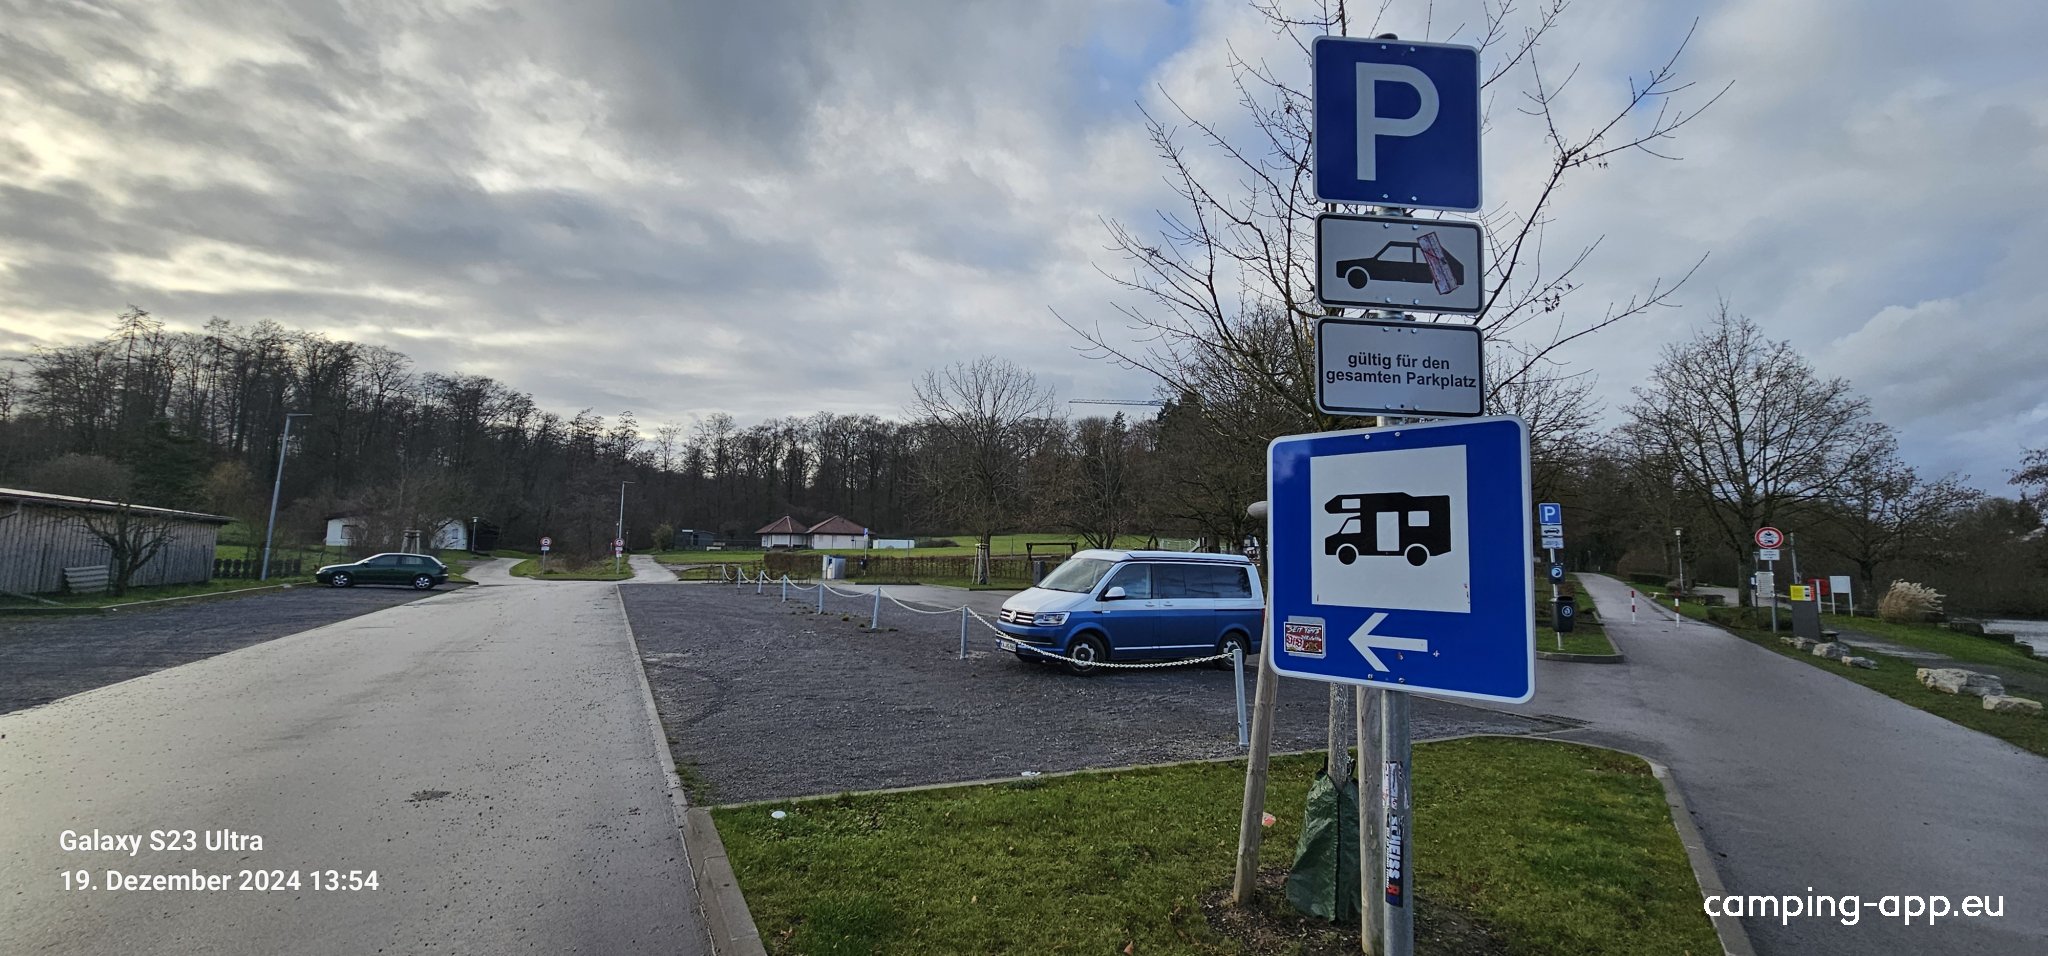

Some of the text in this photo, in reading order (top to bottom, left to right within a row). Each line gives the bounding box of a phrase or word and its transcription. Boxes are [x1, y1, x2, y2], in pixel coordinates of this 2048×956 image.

[1356, 62, 1440, 181] P
[1348, 352, 1450, 369] gültig für den
[1326, 370, 1477, 390] gesamten Parkplatz
[1544, 506, 1556, 522] P
[1388, 815, 1402, 880] SCHEISS
